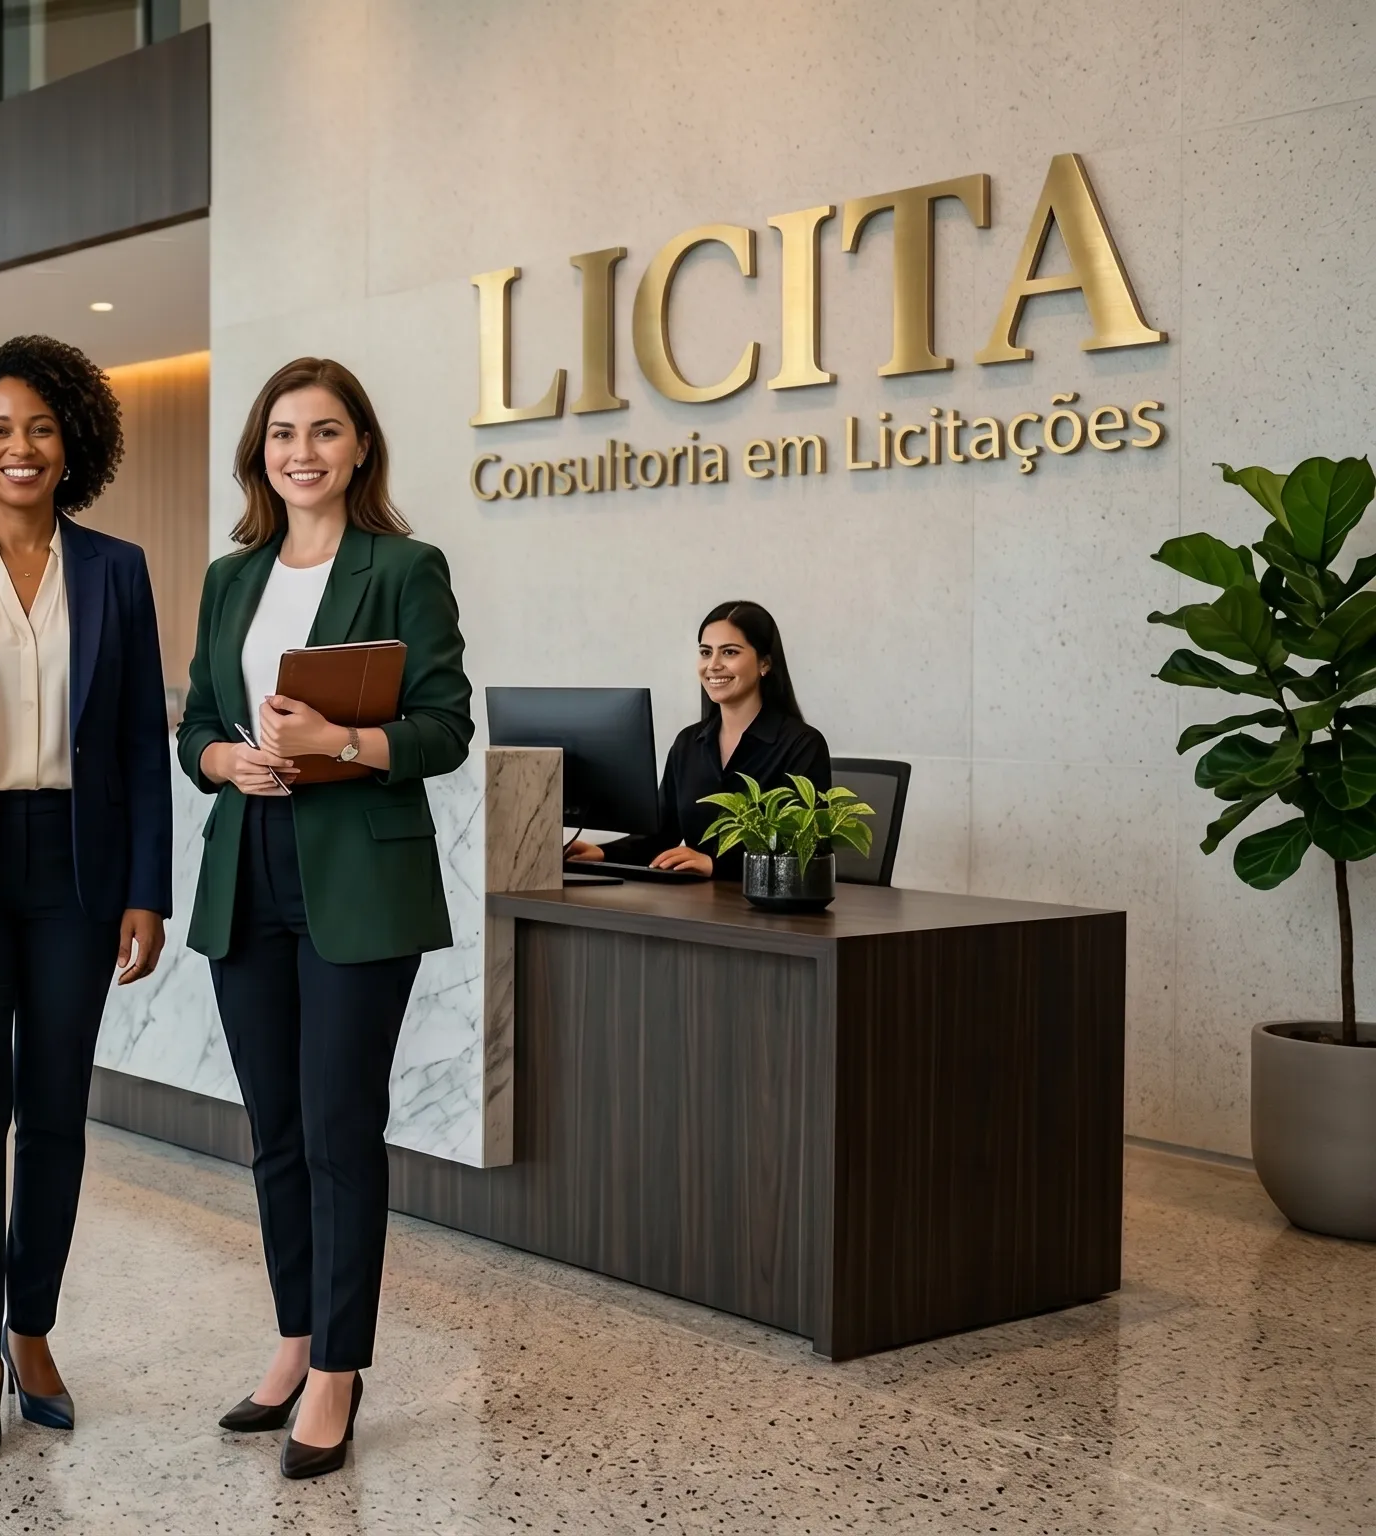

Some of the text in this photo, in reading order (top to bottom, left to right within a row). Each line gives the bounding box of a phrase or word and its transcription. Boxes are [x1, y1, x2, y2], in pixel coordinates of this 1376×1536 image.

[470, 153, 1168, 426] LICITA
[471, 393, 1165, 501] Consultoria em Licitações
